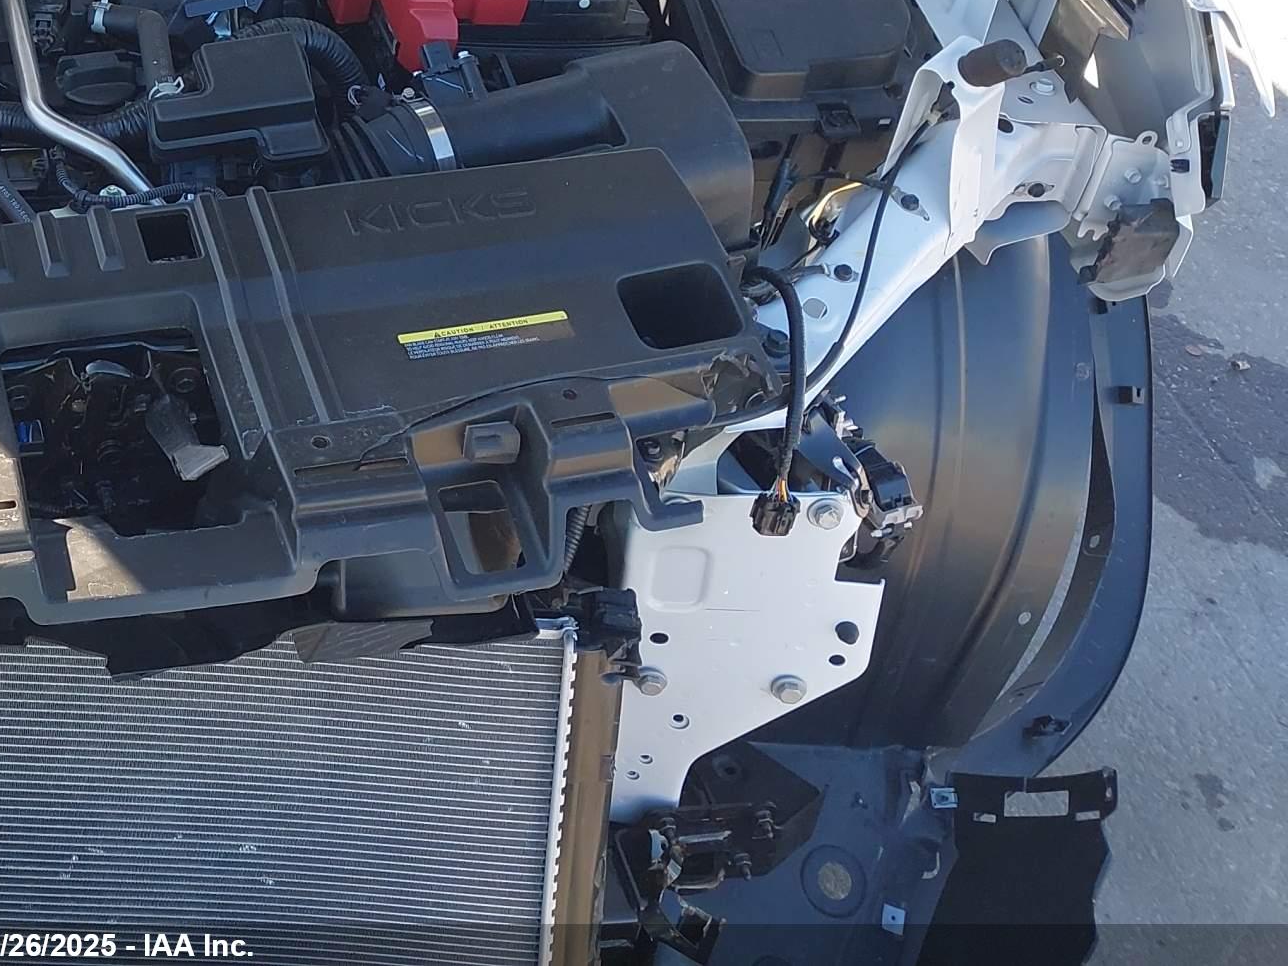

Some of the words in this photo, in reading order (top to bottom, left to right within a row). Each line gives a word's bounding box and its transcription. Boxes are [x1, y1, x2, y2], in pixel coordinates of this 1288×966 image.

[343, 189, 537, 236] KICKS
[441, 327, 474, 338] CAUTION
[489, 318, 529, 331] ATTENTION
